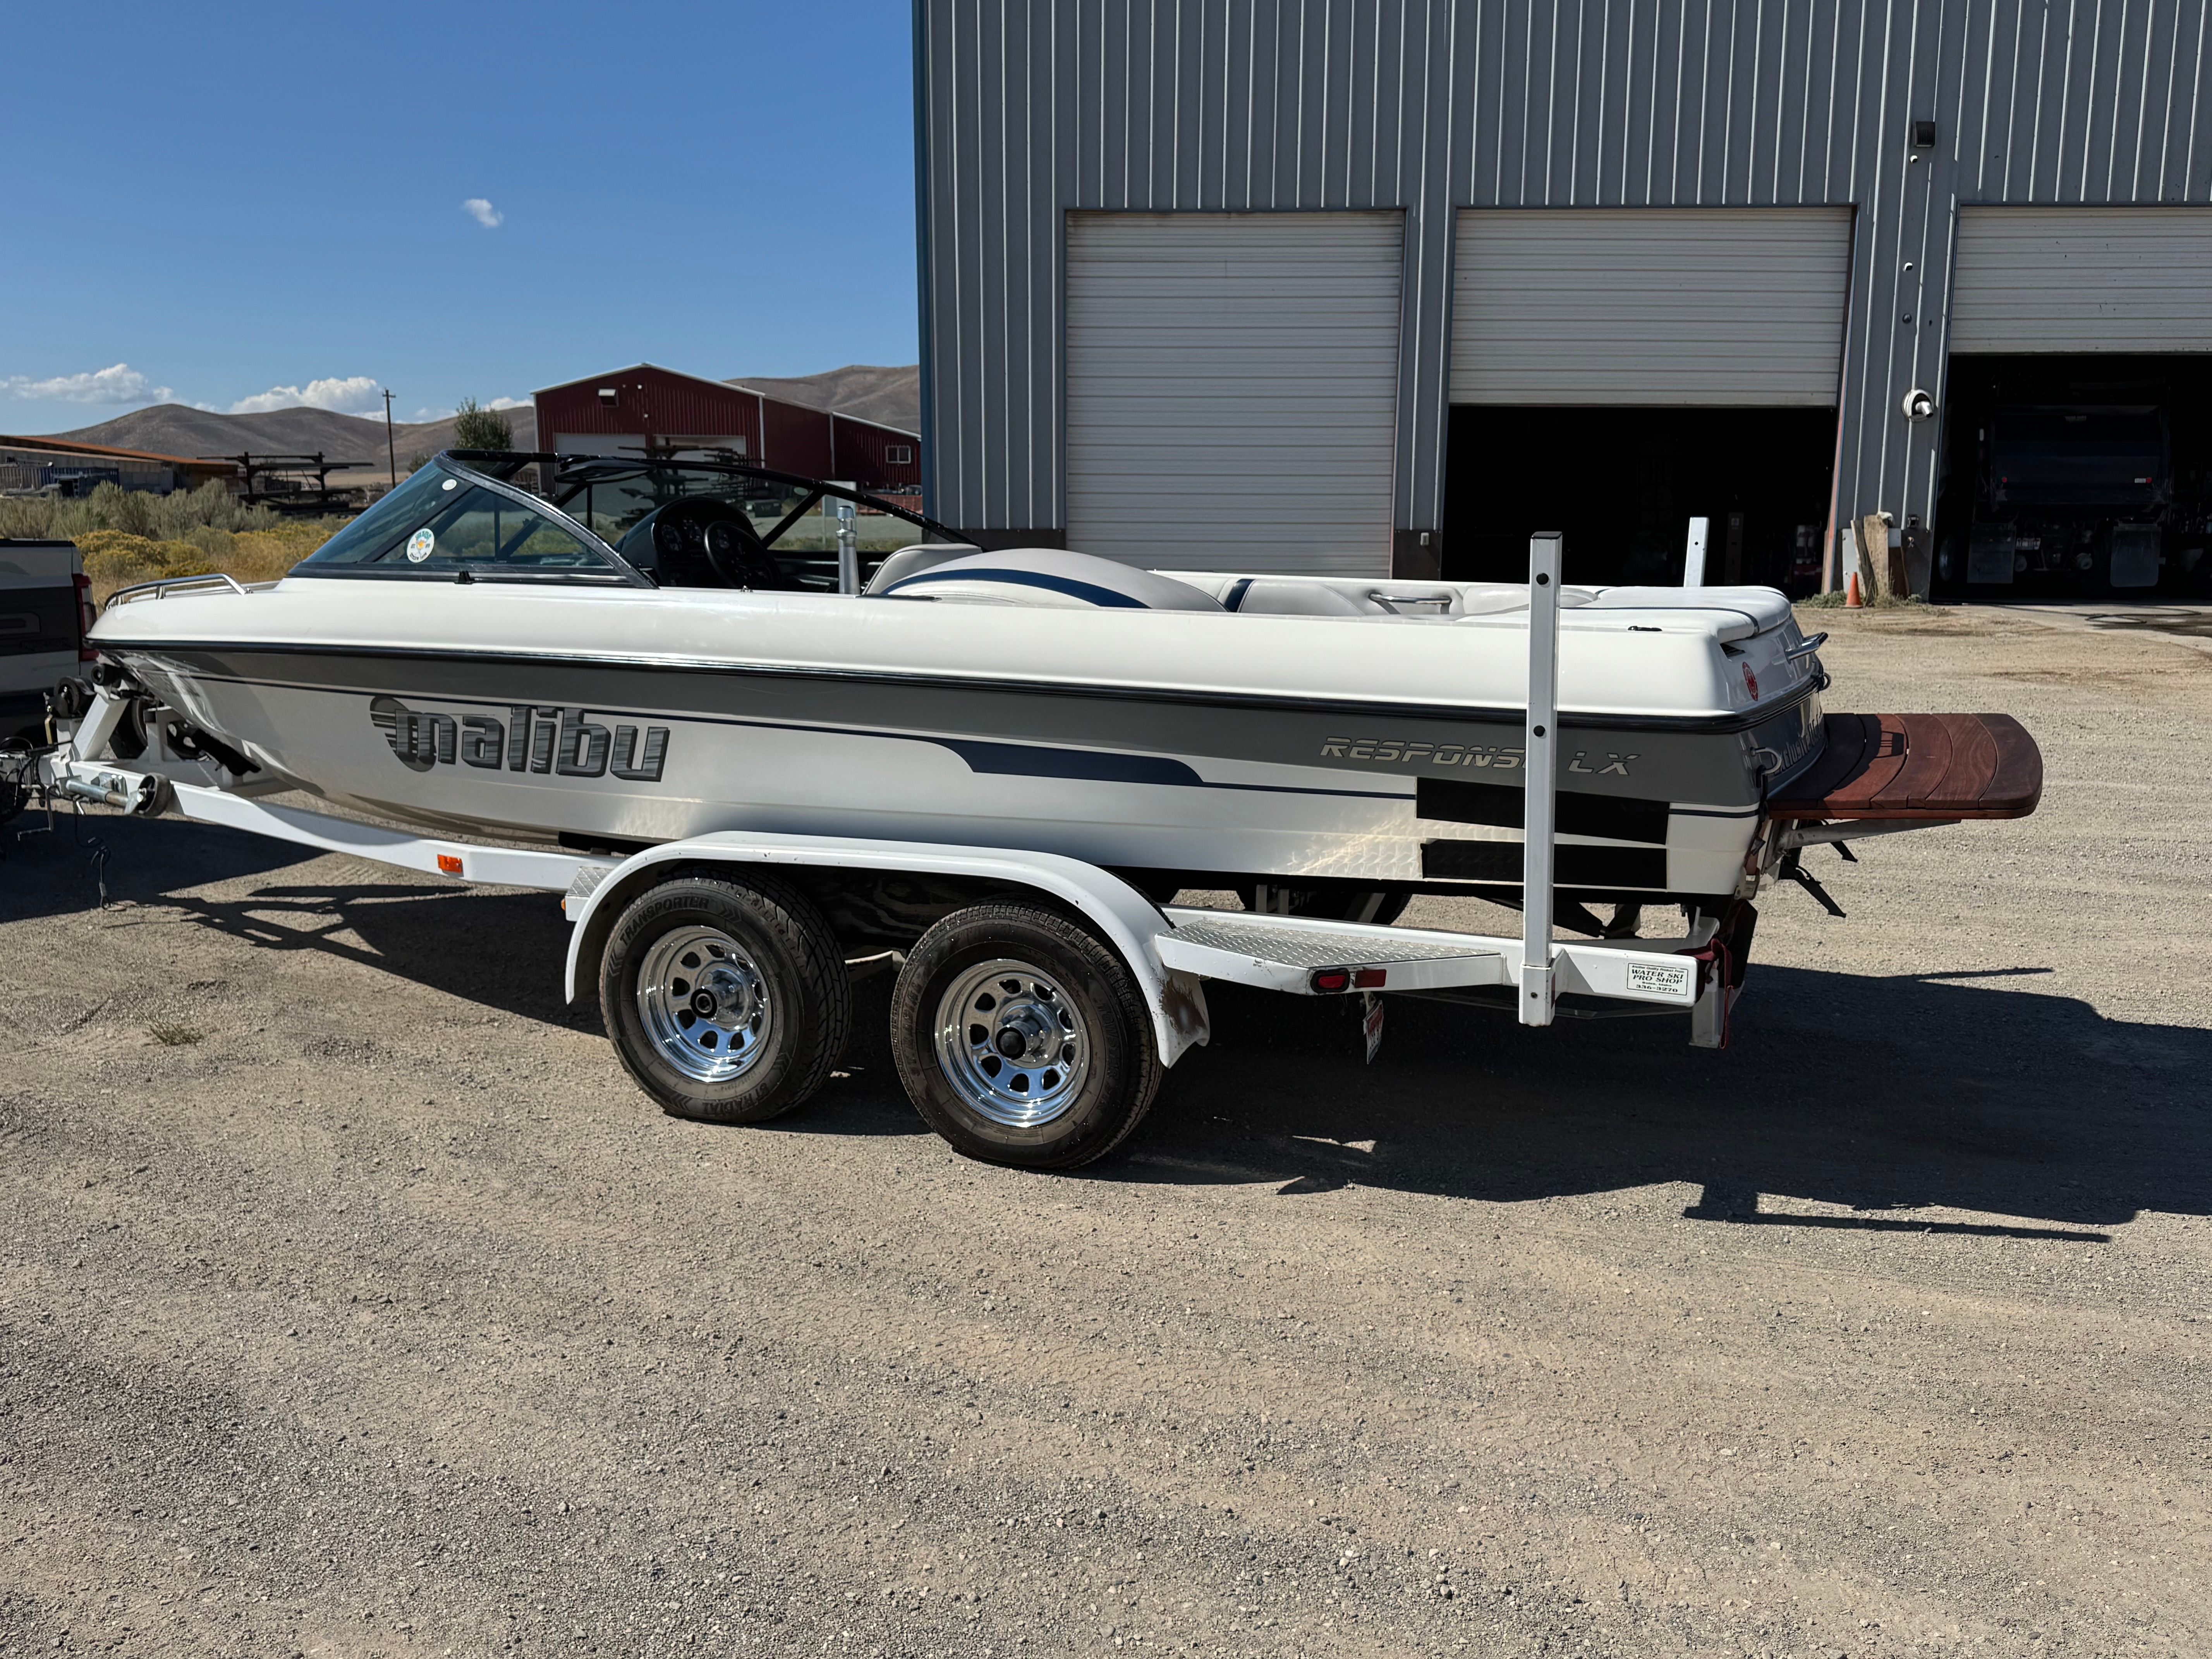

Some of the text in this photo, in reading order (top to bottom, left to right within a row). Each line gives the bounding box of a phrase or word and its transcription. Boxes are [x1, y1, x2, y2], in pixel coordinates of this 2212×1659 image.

[393, 705, 671, 782] malibu
[1320, 736, 1641, 776] RESPONS LX
[620, 896, 710, 945] TRANSPORTER
